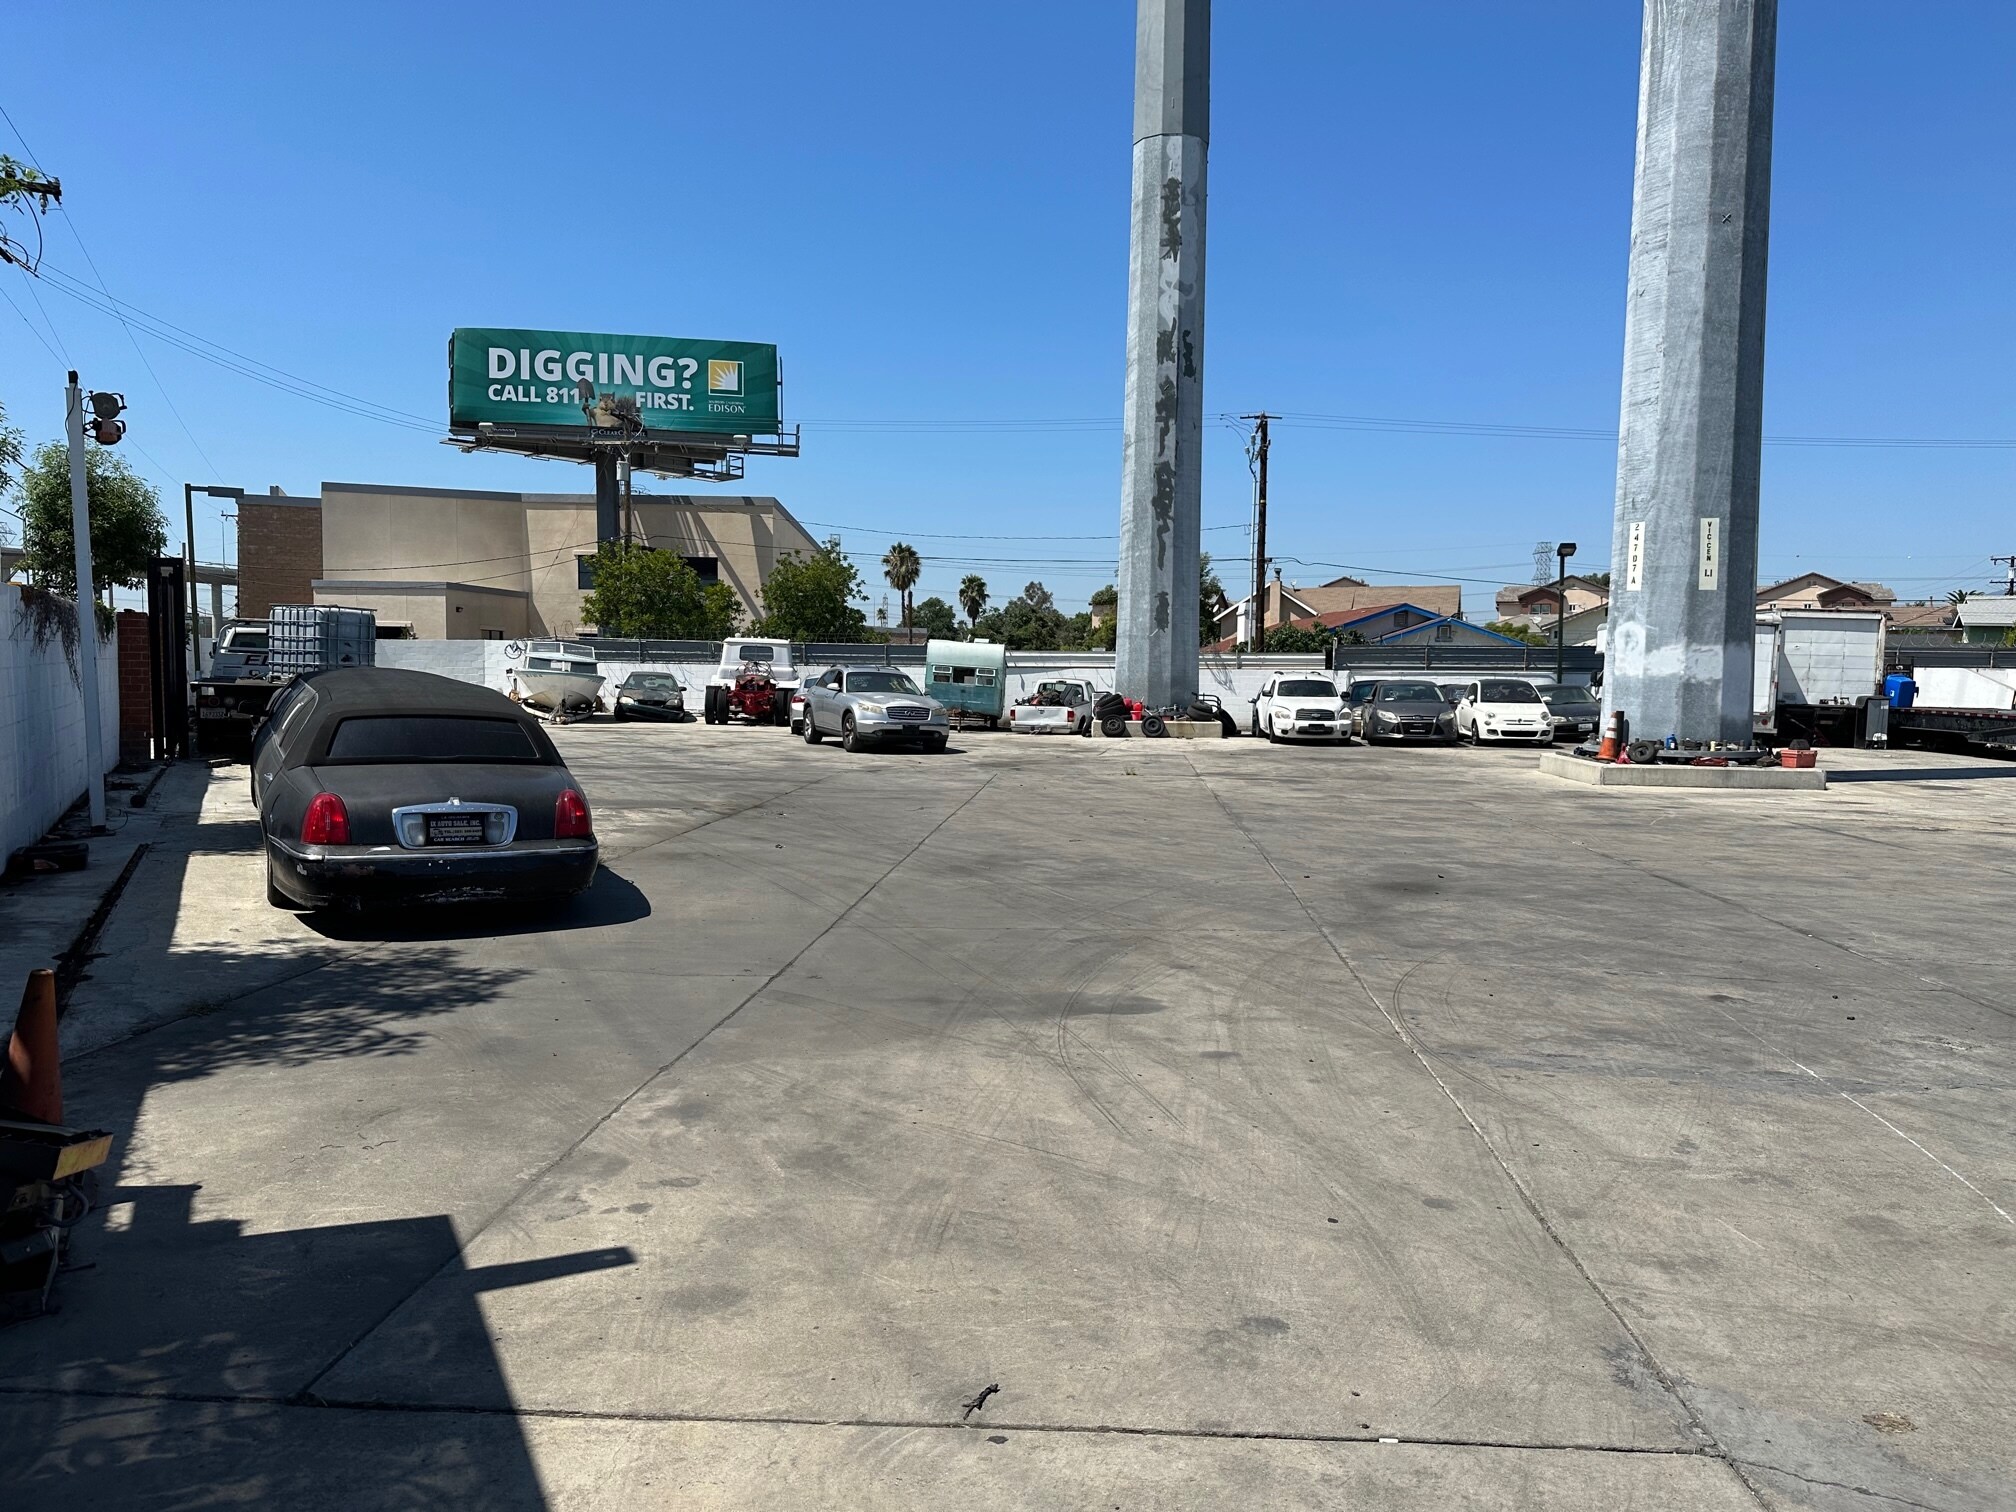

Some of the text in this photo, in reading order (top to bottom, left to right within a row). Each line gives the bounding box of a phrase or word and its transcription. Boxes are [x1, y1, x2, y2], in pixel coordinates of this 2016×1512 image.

[488, 347, 698, 389] DIGGING?
[488, 384, 695, 411] CALL 811 FIRST.
[708, 404, 745, 414] EDISON
